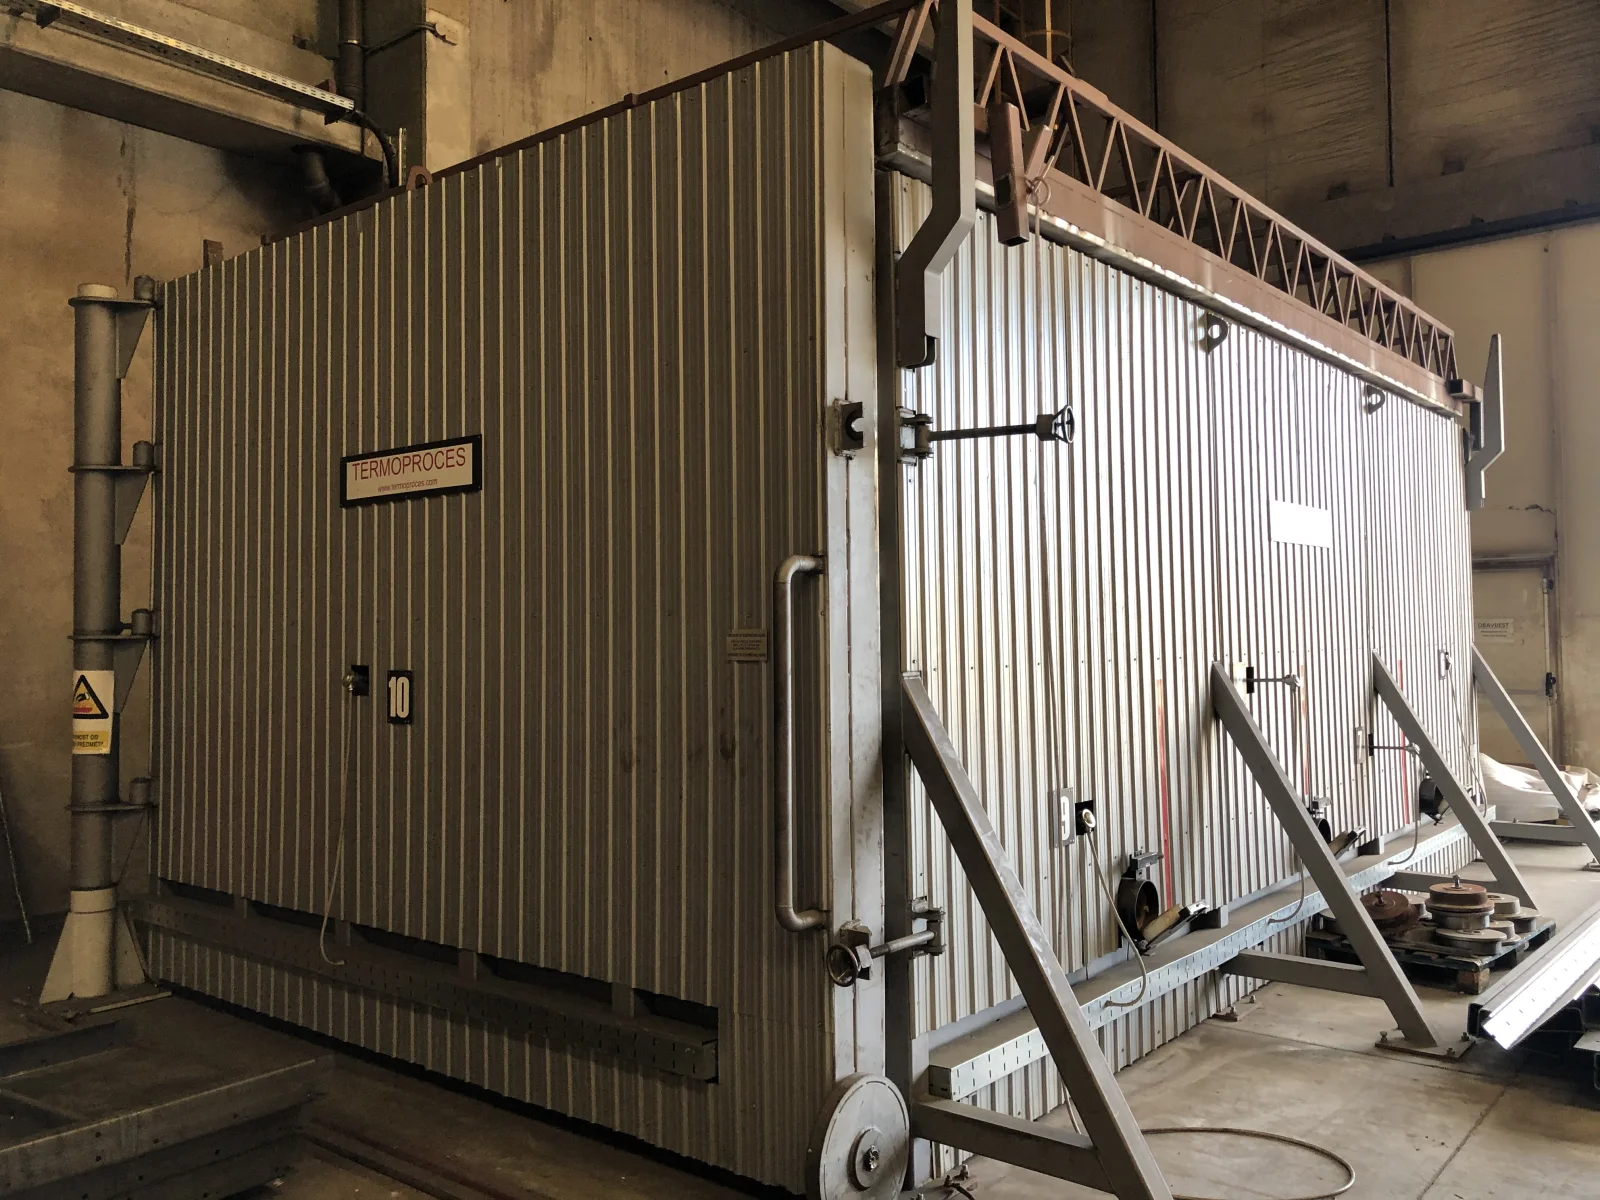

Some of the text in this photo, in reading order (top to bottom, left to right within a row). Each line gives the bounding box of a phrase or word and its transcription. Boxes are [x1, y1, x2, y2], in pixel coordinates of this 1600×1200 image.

[352, 447, 466, 481] TERMOPROCES
[377, 478, 438, 493] www.termoproces.com
[388, 676, 410, 718] 10
